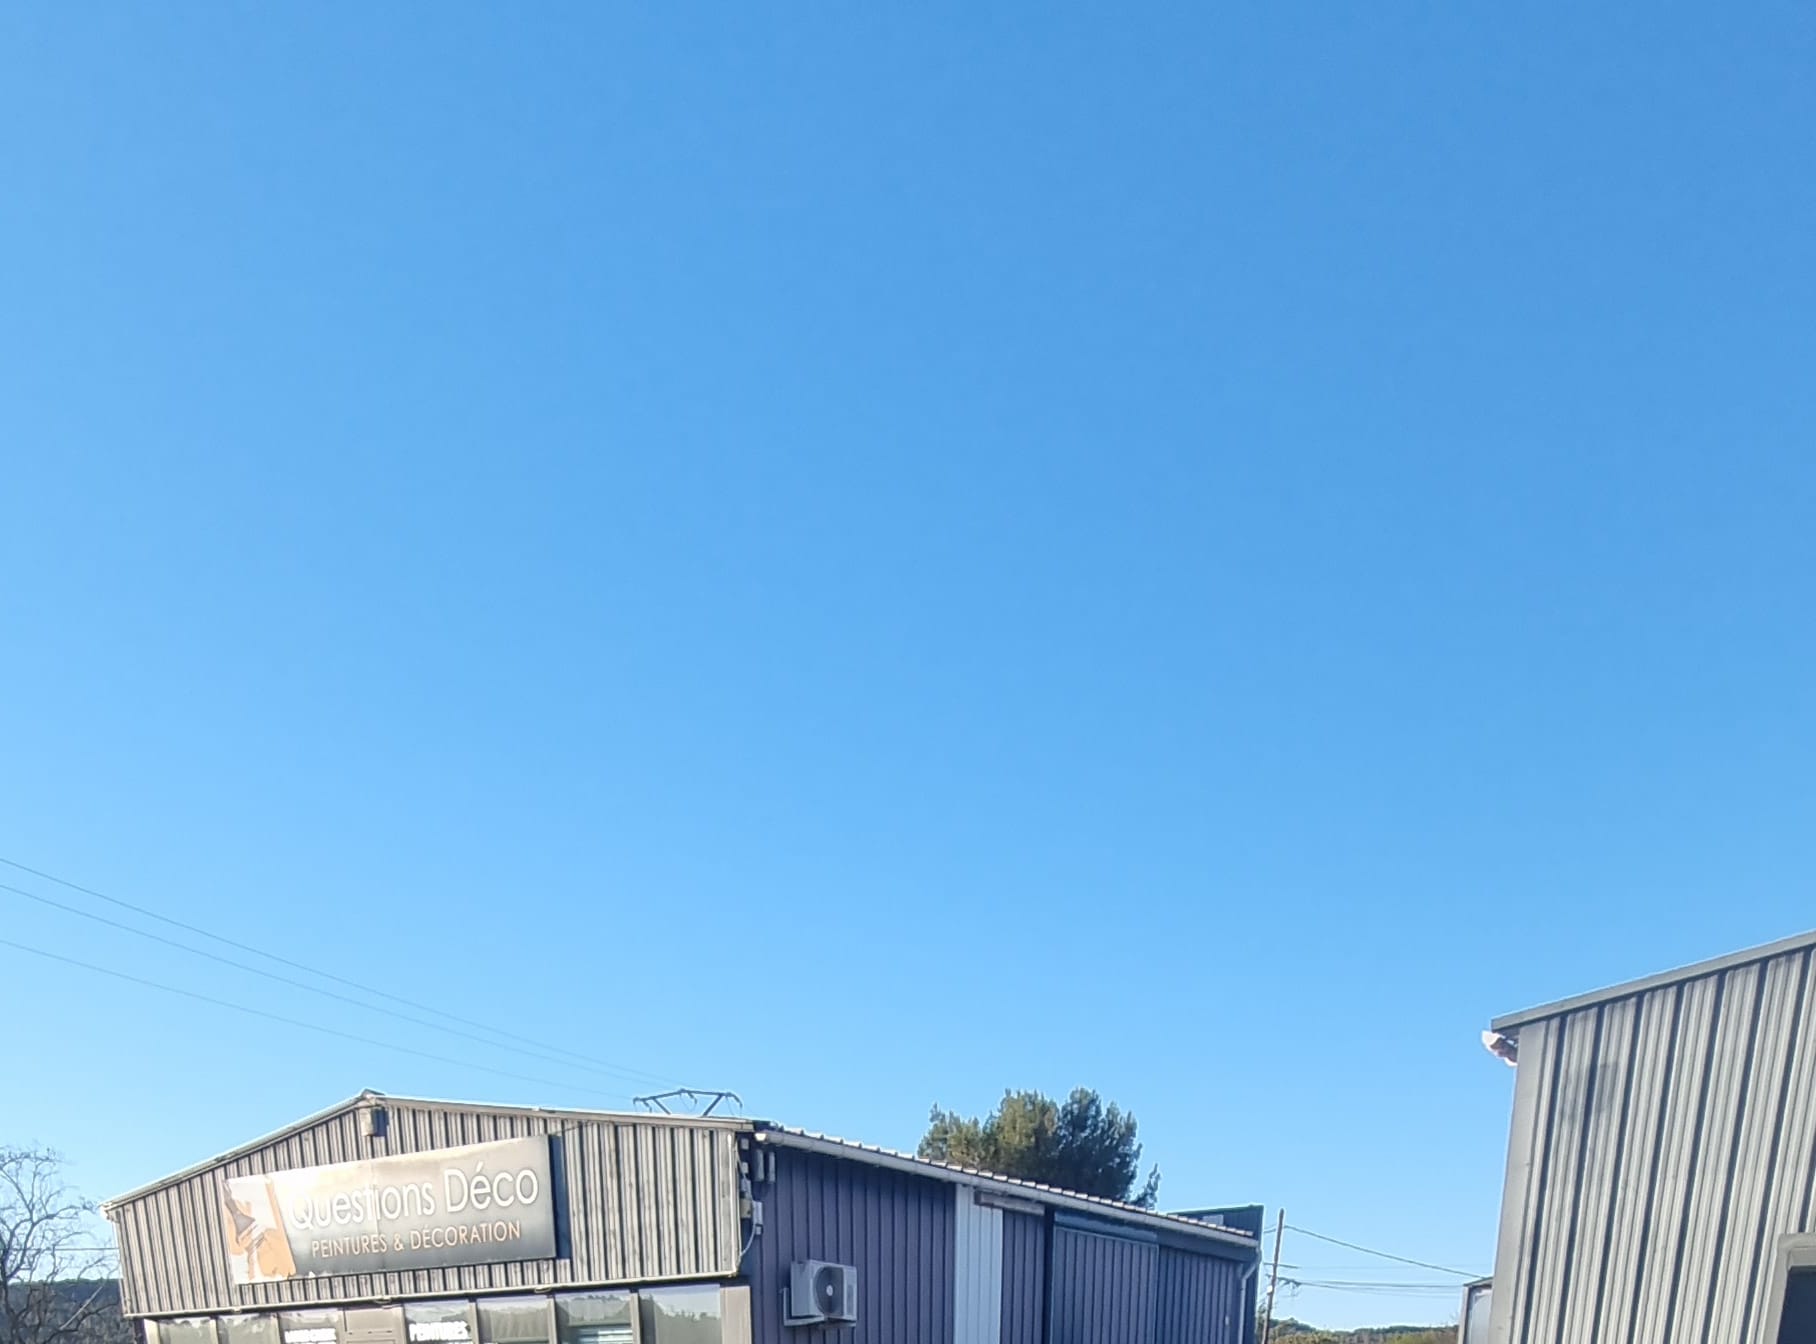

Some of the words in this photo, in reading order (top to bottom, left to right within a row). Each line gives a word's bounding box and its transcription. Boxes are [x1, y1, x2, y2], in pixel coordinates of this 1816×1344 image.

[289, 1180, 435, 1231] Questions
[443, 1161, 539, 1215] Déco
[311, 1235, 387, 1258] PEINTURES
[394, 1235, 404, 1251] &
[410, 1220, 521, 1250] DÉCORATION
